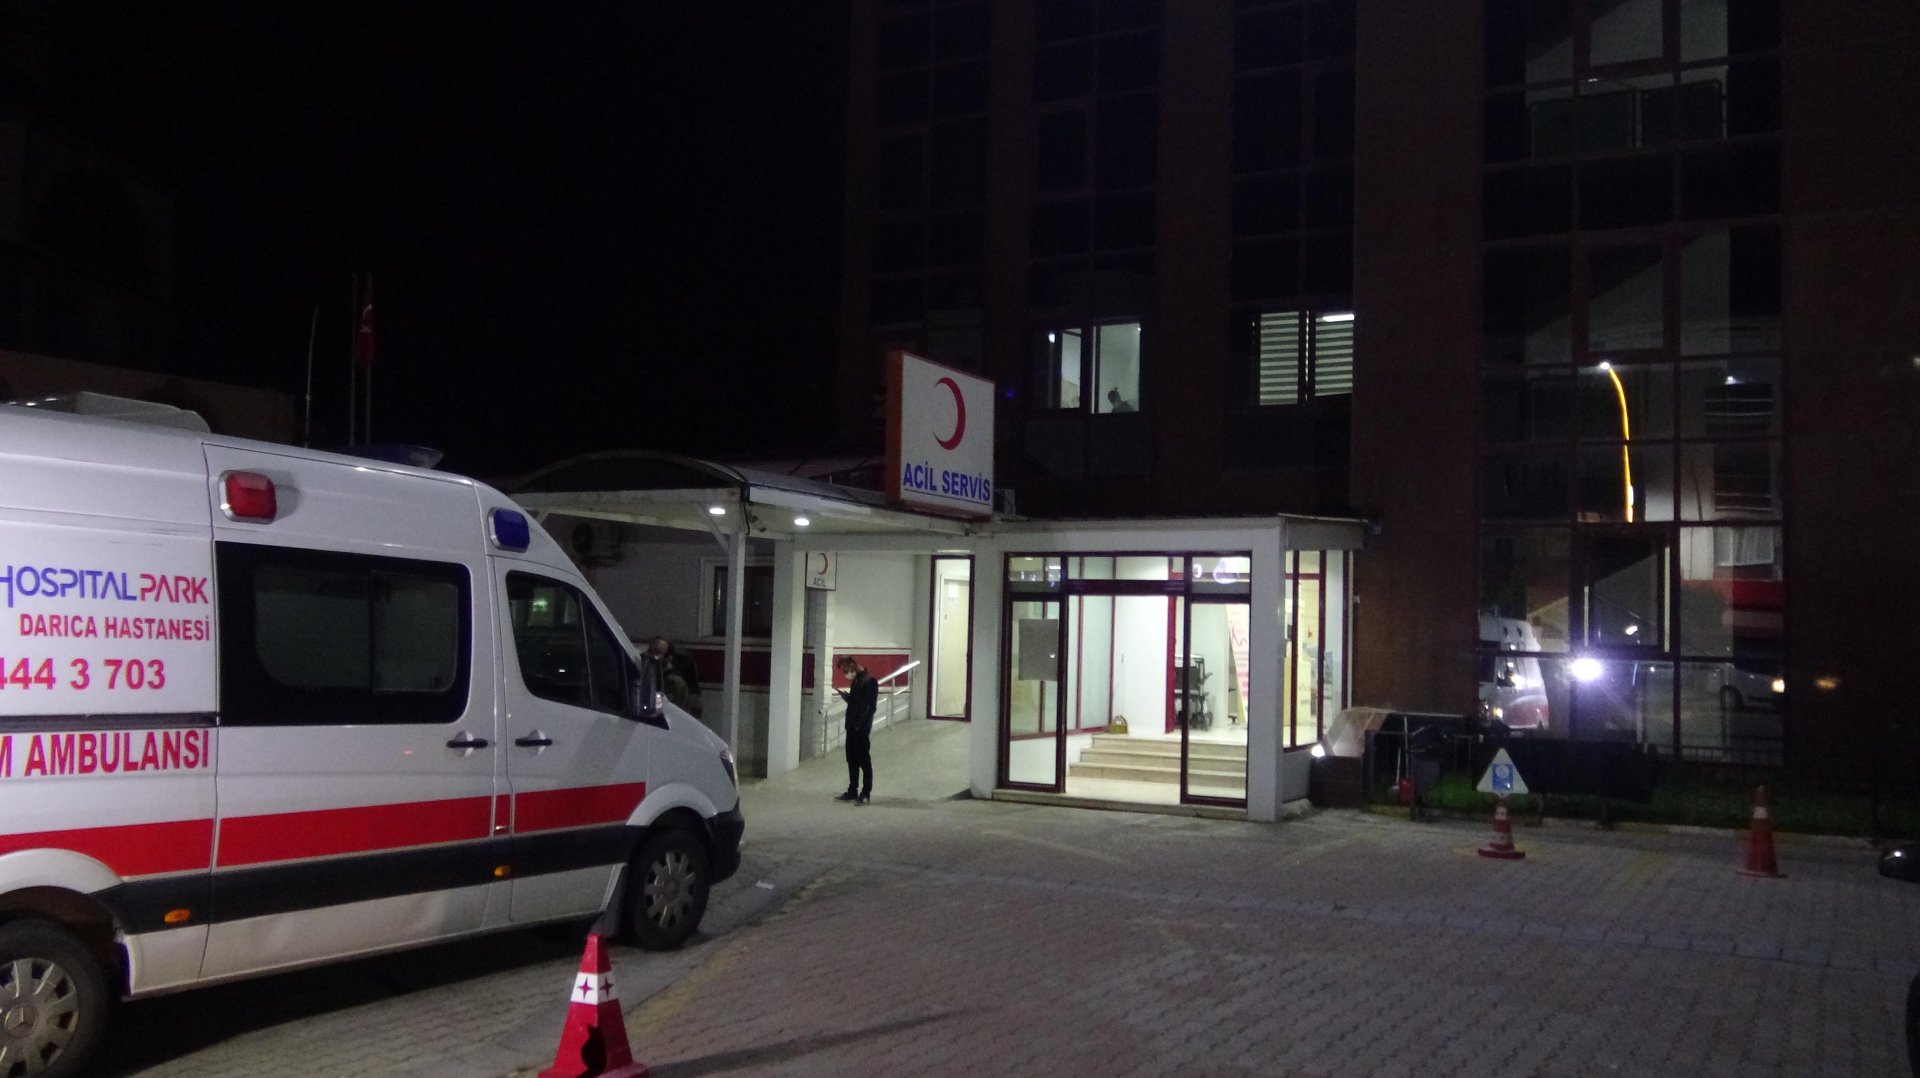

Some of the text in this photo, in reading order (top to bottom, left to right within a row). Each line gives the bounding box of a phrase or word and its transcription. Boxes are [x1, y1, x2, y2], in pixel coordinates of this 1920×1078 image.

[903, 461, 991, 501] ACİL SERVİS
[19, 613, 210, 641] DARICA HASTANESİ
[70, 658, 90, 689] 3
[104, 659, 166, 689] 703
[24, 730, 209, 777] AMBULANSI
